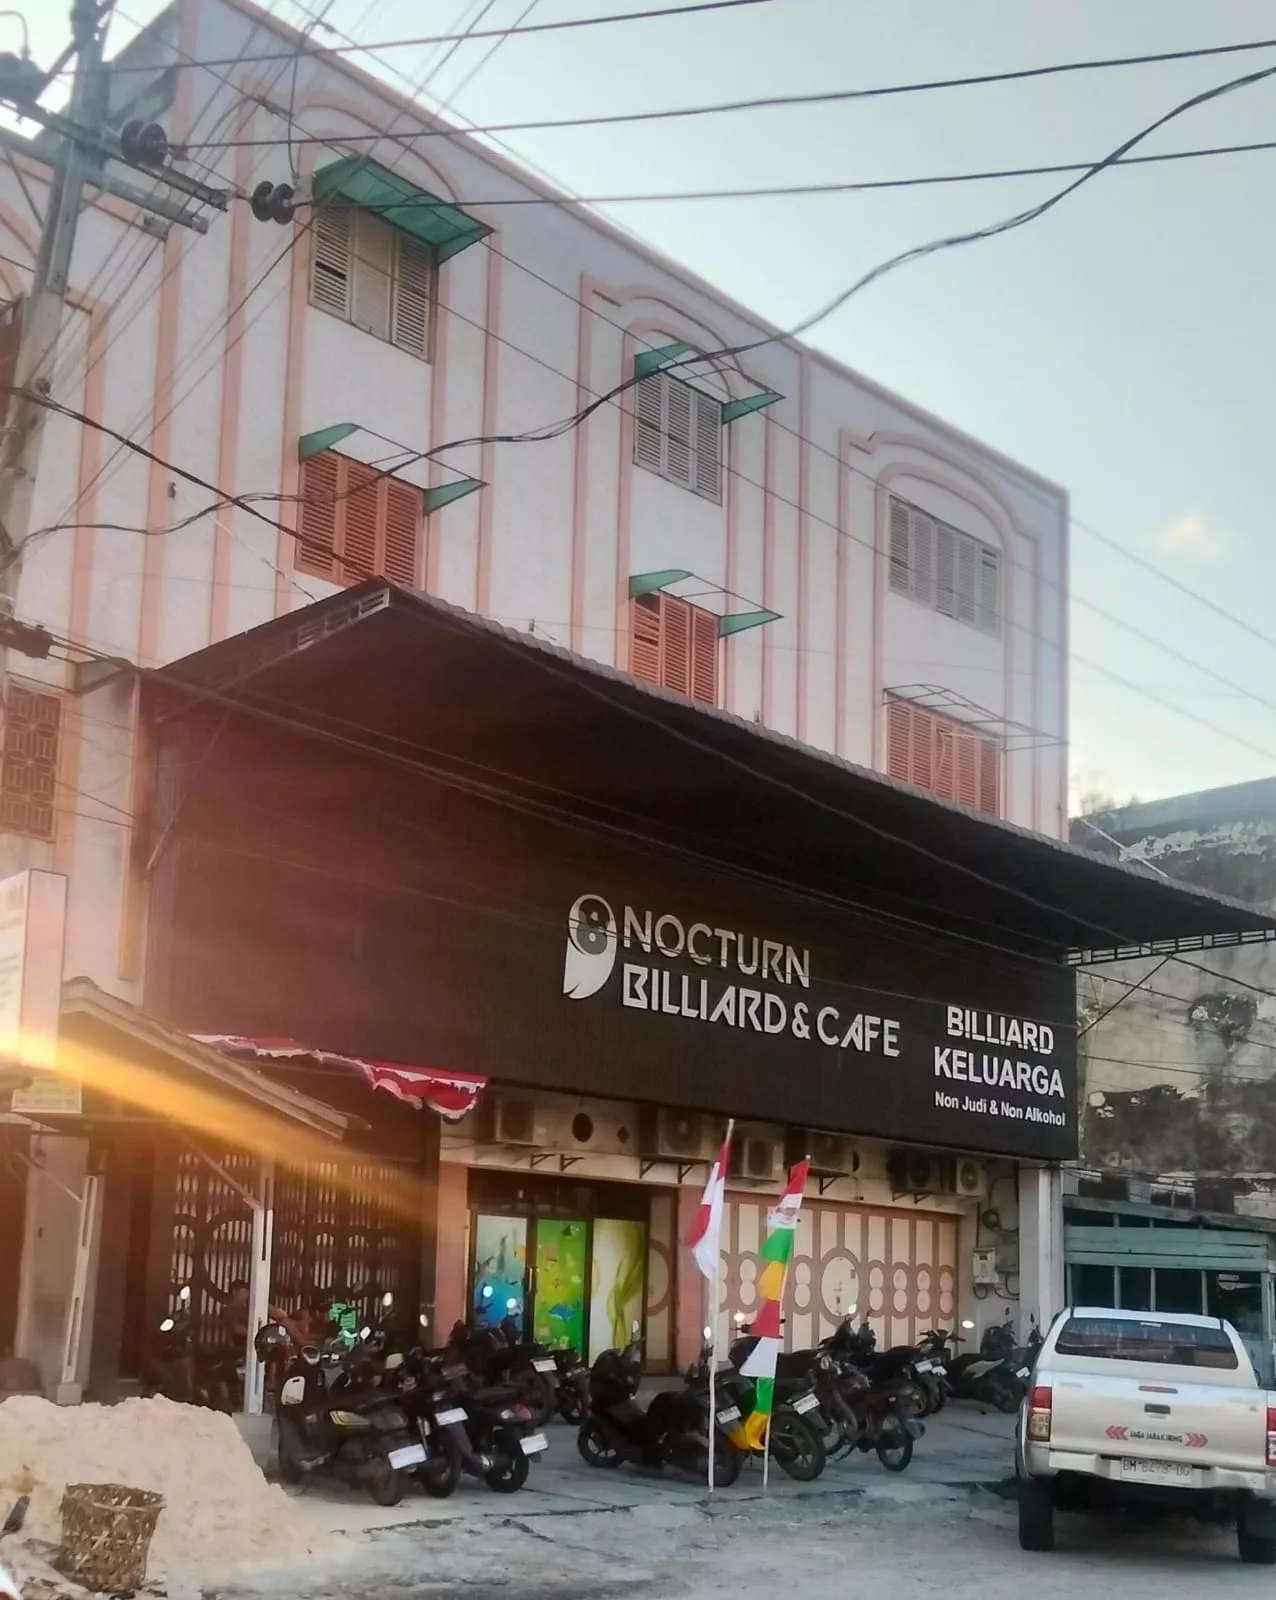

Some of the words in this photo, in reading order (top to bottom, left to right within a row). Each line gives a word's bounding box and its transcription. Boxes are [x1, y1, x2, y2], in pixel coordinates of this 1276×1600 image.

[623, 905, 810, 988] NOCTURN
[622, 963, 787, 1034] BILLIARD
[791, 1002, 811, 1040] &
[816, 1006, 900, 1057] CAFE
[947, 1005, 1054, 1055] BILLIARD
[934, 1046, 1065, 1099] KELUARGA
[935, 1091, 959, 1109] Non
[961, 1096, 987, 1113] Judi
[989, 1100, 998, 1115] &
[1000, 1101, 1023, 1119] Non
[1025, 1106, 1066, 1126] Alkohol
